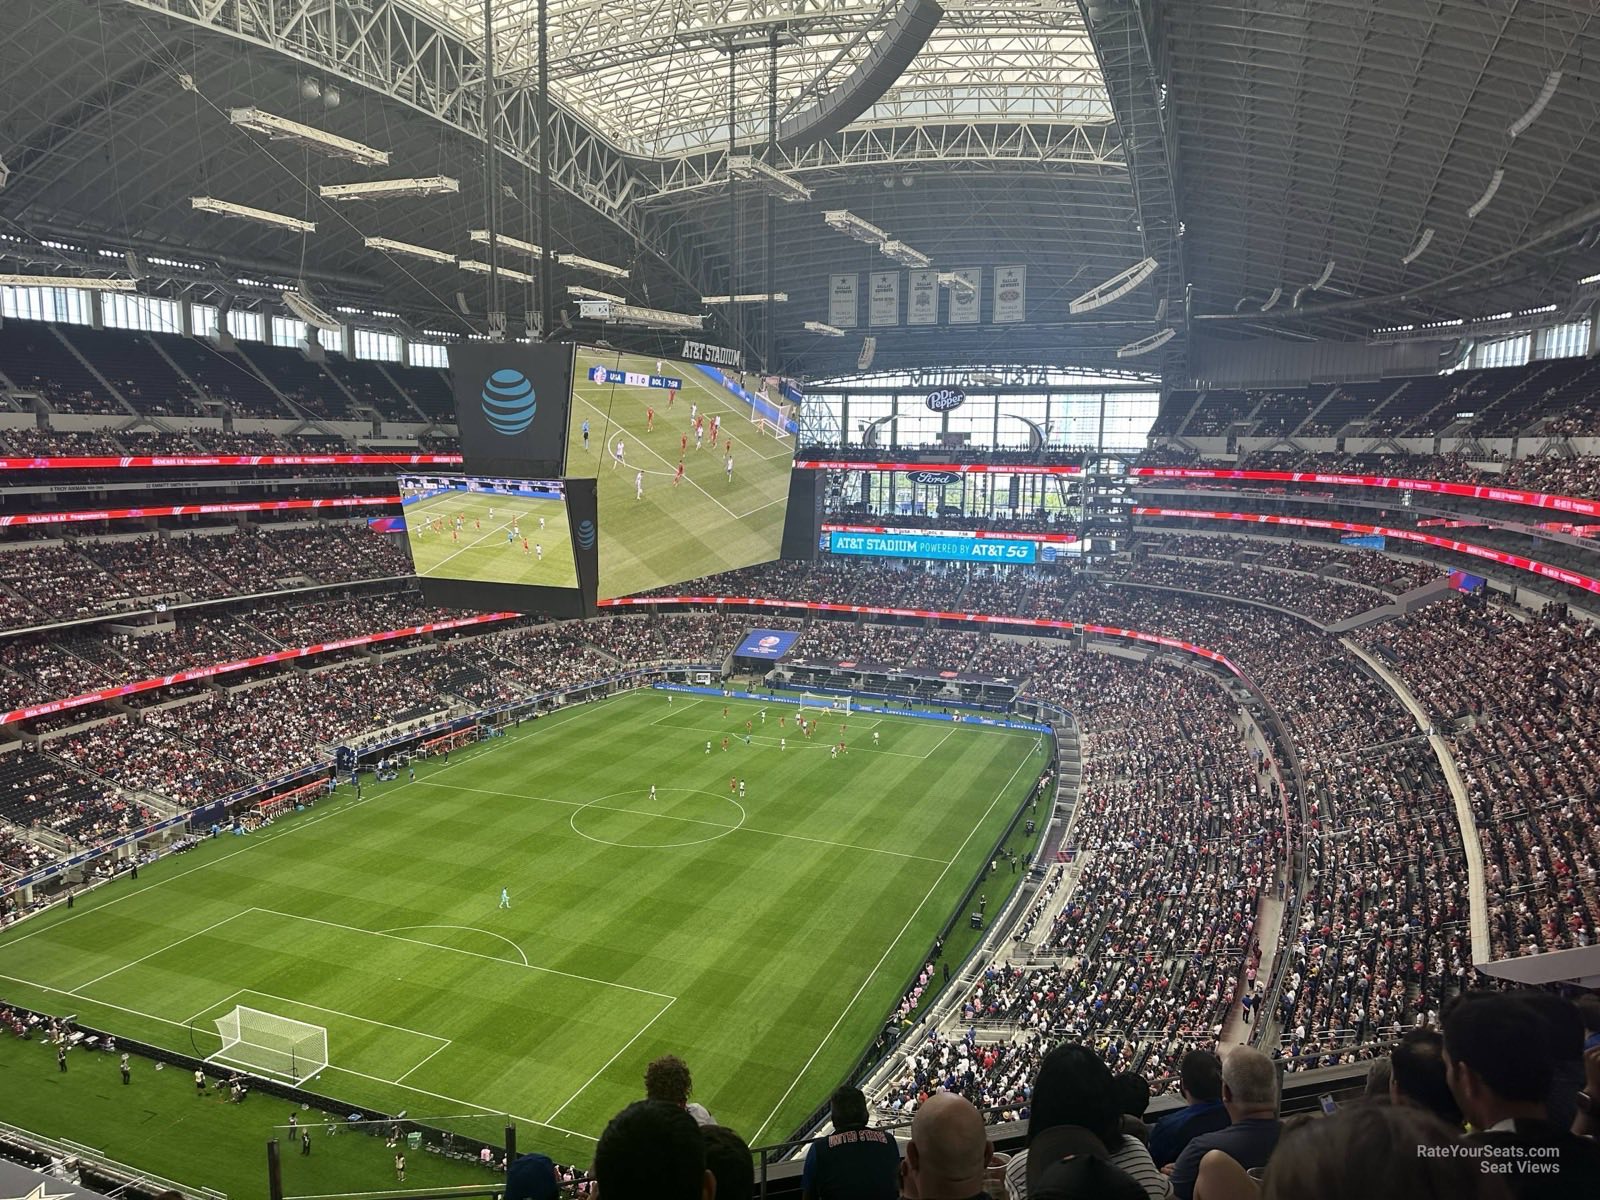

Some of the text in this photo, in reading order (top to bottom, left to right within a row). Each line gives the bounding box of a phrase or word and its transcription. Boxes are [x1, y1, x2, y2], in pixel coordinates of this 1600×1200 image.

[682, 340, 741, 366] AT&T STADIUM
[609, 373, 622, 381] USA
[930, 391, 964, 410] Pepper
[940, 389, 955, 400] Dr
[916, 473, 950, 483] Ford
[836, 537, 1028, 558] AT&T STADIUM POWERED BY AT&T 5G
[829, 1129, 888, 1147] UNITED STATES
